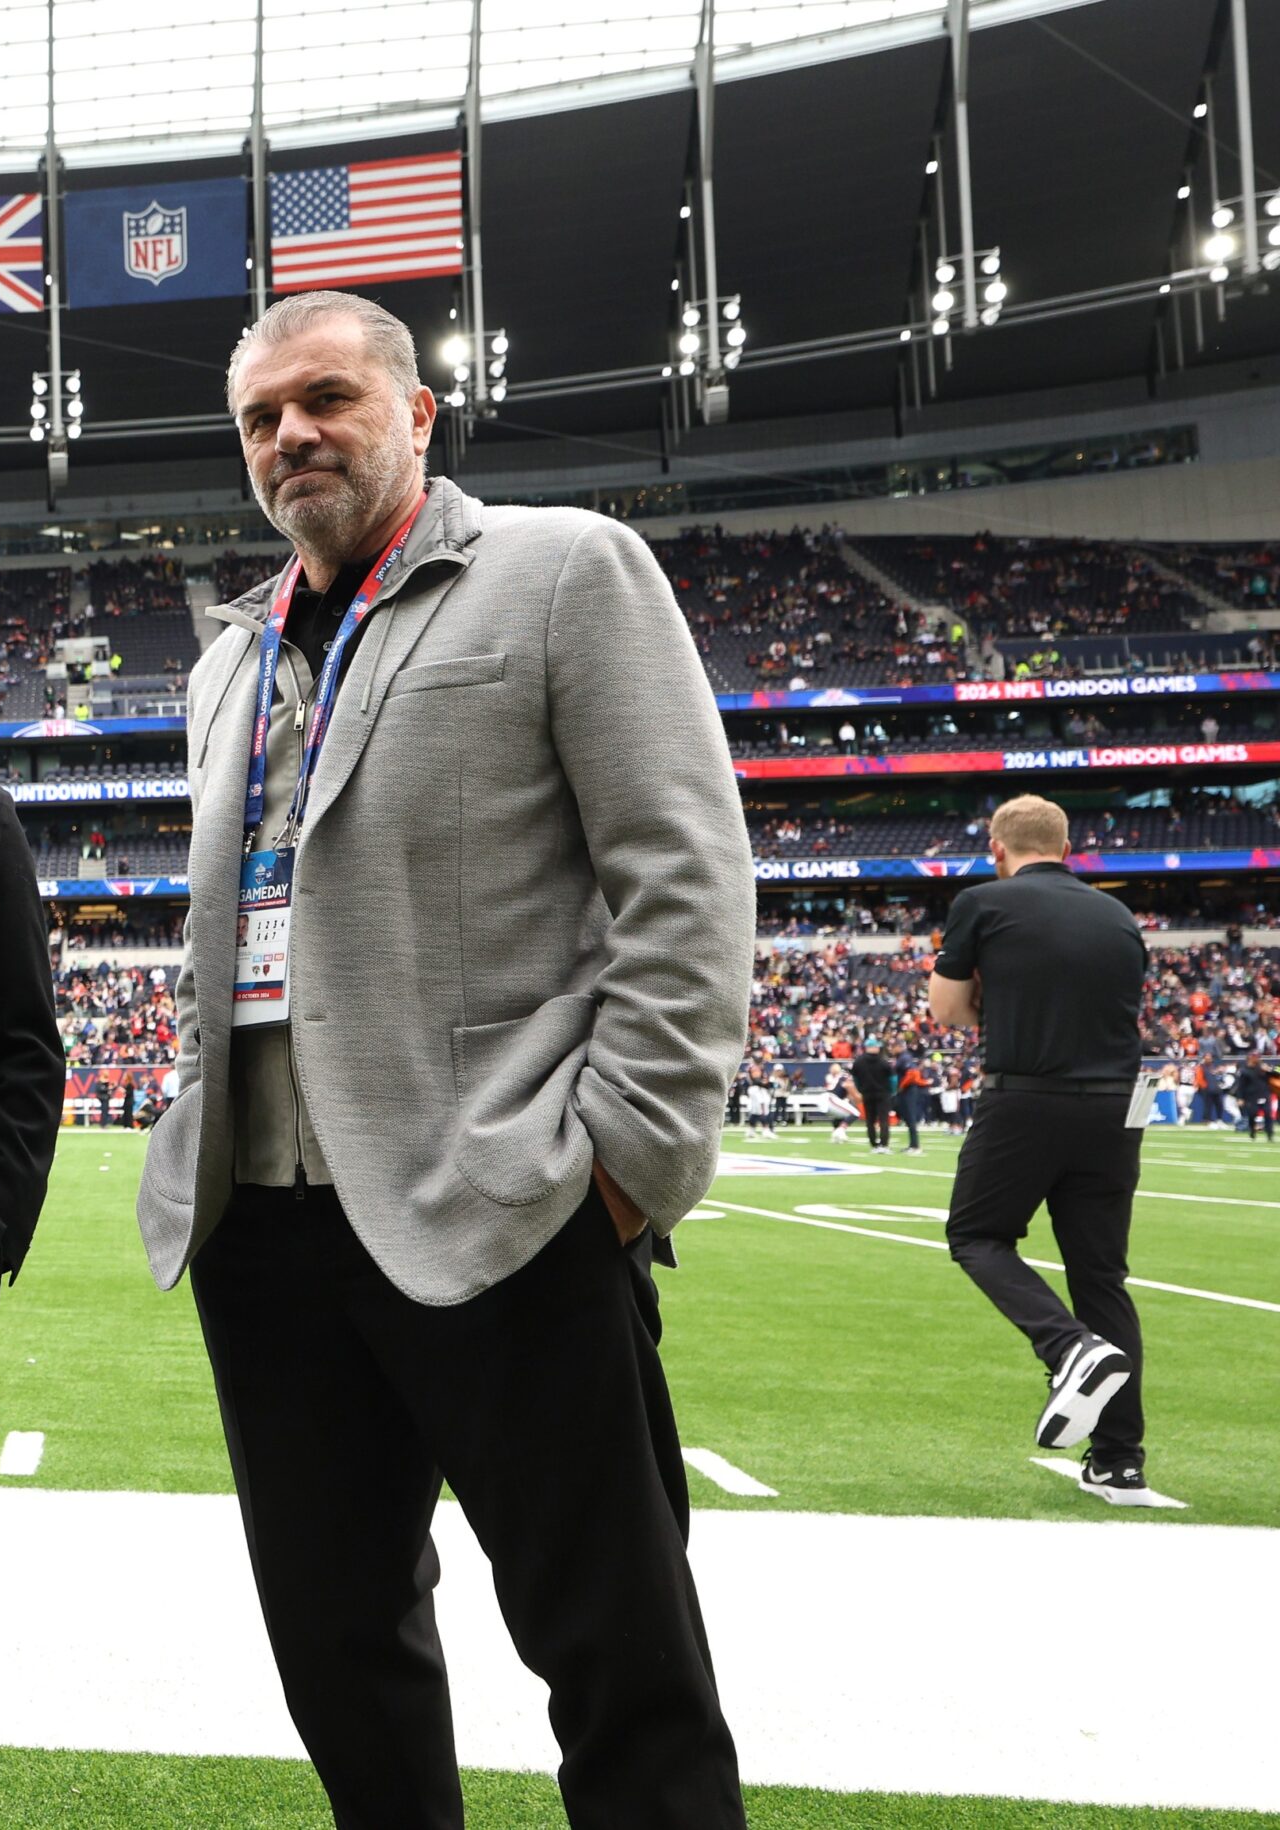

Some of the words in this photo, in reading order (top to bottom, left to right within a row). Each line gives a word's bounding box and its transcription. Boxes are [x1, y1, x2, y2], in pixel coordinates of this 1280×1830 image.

[133, 238, 179, 272] NFL
[264, 648, 274, 676] GAMES
[260, 677, 271, 715] LONDON
[318, 664, 333, 704] LONDON
[957, 684, 1001, 700] 2024
[1005, 683, 1042, 699] NFL
[1045, 679, 1129, 697] LONDON
[1130, 675, 1198, 694] GAMES
[1004, 752, 1048, 769] 2024
[1050, 750, 1089, 768] NFL
[1089, 746, 1177, 766] LONDON
[1179, 743, 1249, 763] GAMES
[104, 782, 128, 799] TO
[132, 780, 191, 798] KICKO
[792, 860, 861, 878] GAMES
[240, 883, 289, 902] GAMEDAY
